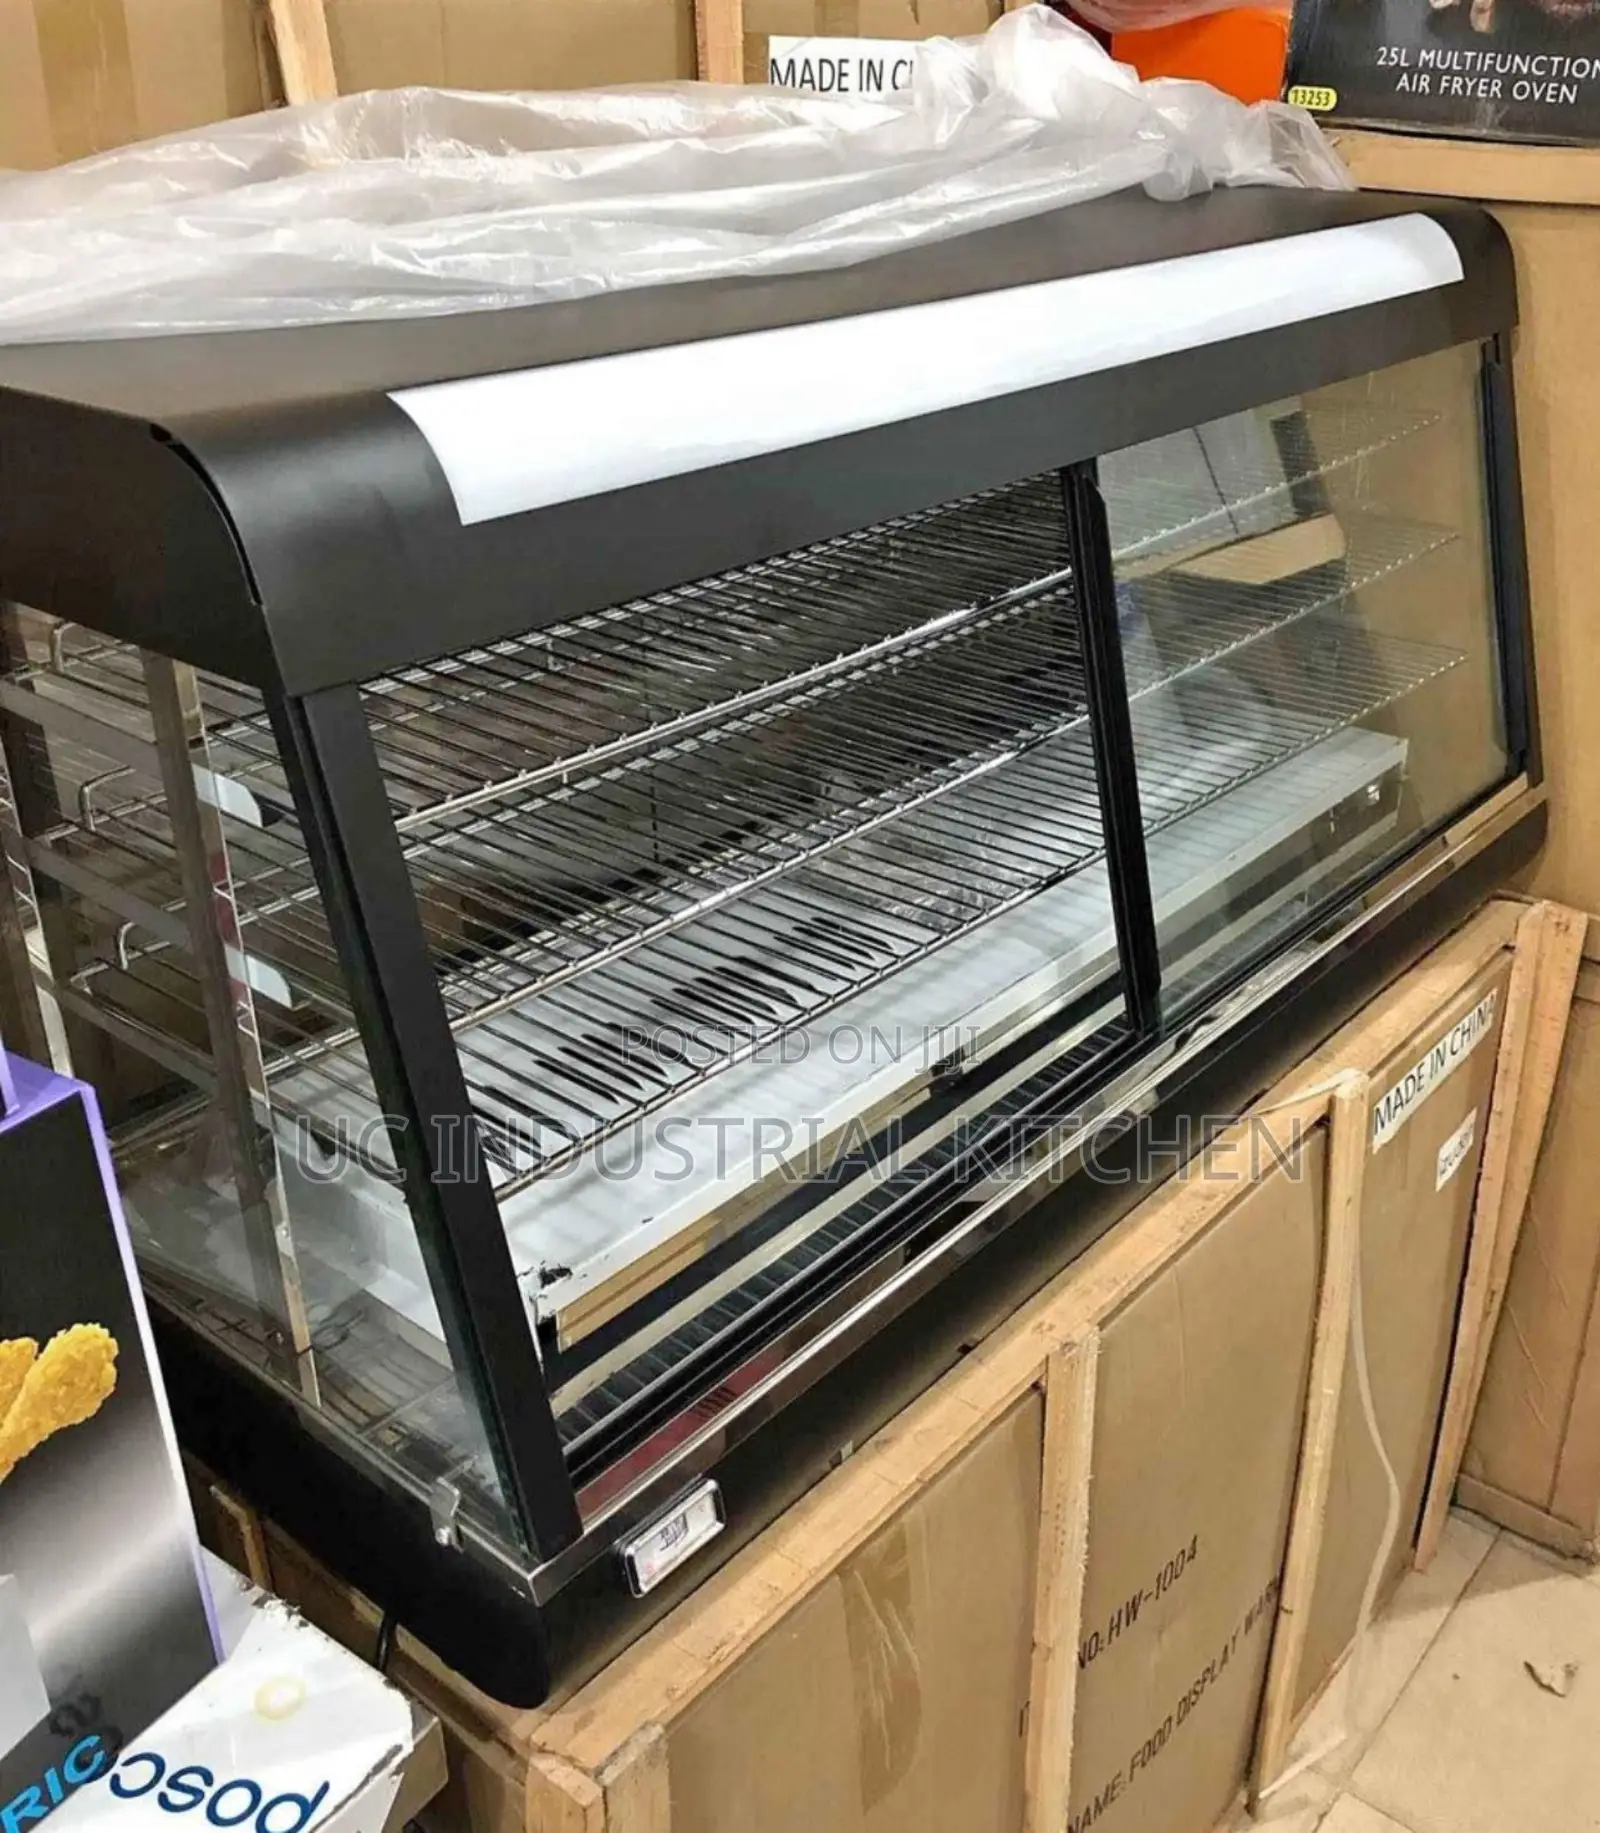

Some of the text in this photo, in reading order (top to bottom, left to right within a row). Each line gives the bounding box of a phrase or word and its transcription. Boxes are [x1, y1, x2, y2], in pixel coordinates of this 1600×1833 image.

[1376, 47, 1410, 68] 25L
[769, 58, 914, 93] MADE IN C
[1395, 72, 1578, 105] AIR FRYER OVEN
[1291, 88, 1331, 107] 13253
[1373, 1060, 1426, 1136] MADE
[1430, 1043, 1447, 1081] IN
[1107, 1533, 1198, 1646] HW-1004
[1129, 1715, 1173, 1783] FOOD
[1175, 1625, 1240, 1728] DISPLAY
